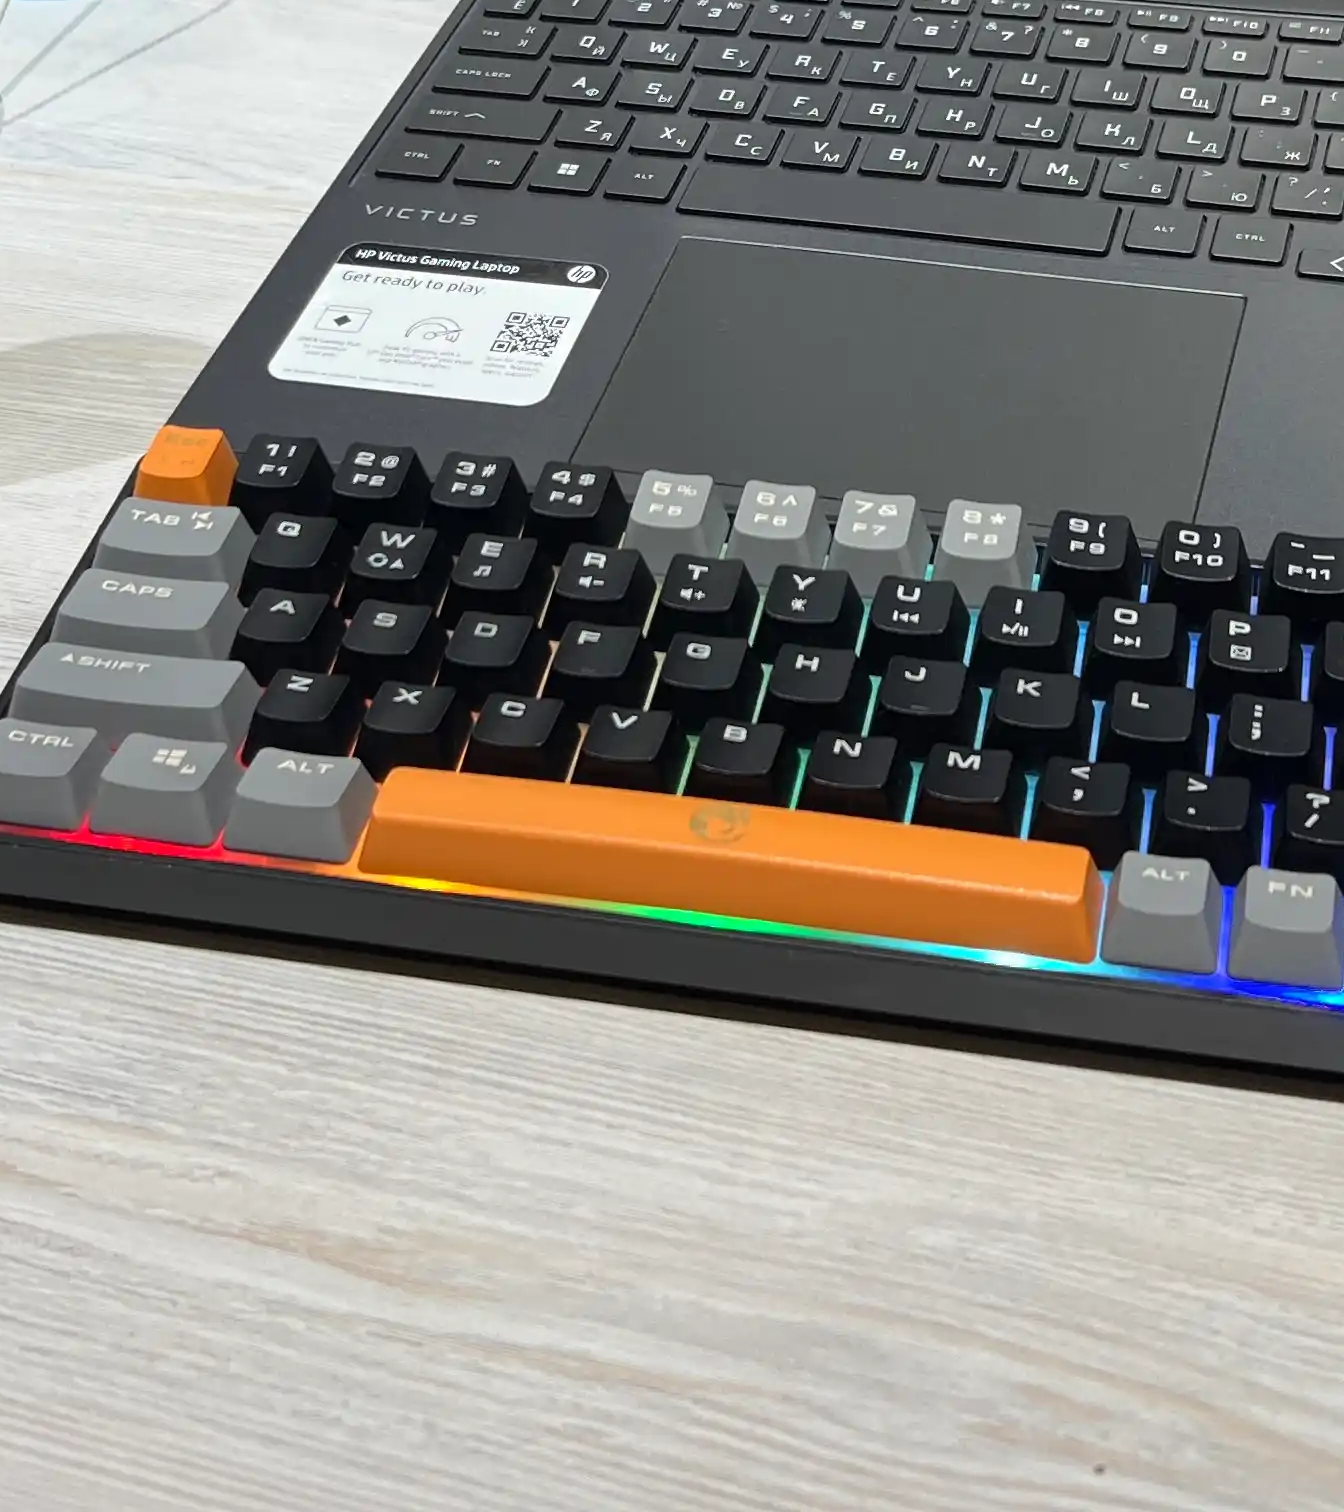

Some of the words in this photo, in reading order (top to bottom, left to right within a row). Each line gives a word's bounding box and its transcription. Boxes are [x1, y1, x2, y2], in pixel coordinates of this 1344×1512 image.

[364, 202, 480, 227] VICTUS
[355, 248, 377, 260] HP
[377, 249, 419, 265] Victus
[419, 254, 471, 272] Gaming
[472, 258, 521, 276] Laptop
[342, 269, 370, 284] Get
[371, 272, 424, 290] ready
[426, 277, 445, 290] to
[130, 508, 181, 527] TAB
[101, 578, 174, 598] CAPS
[8, 728, 75, 750] CTRL
[277, 757, 335, 776] ALT
[1142, 866, 1191, 882] ALT
[1267, 880, 1315, 898] FN
